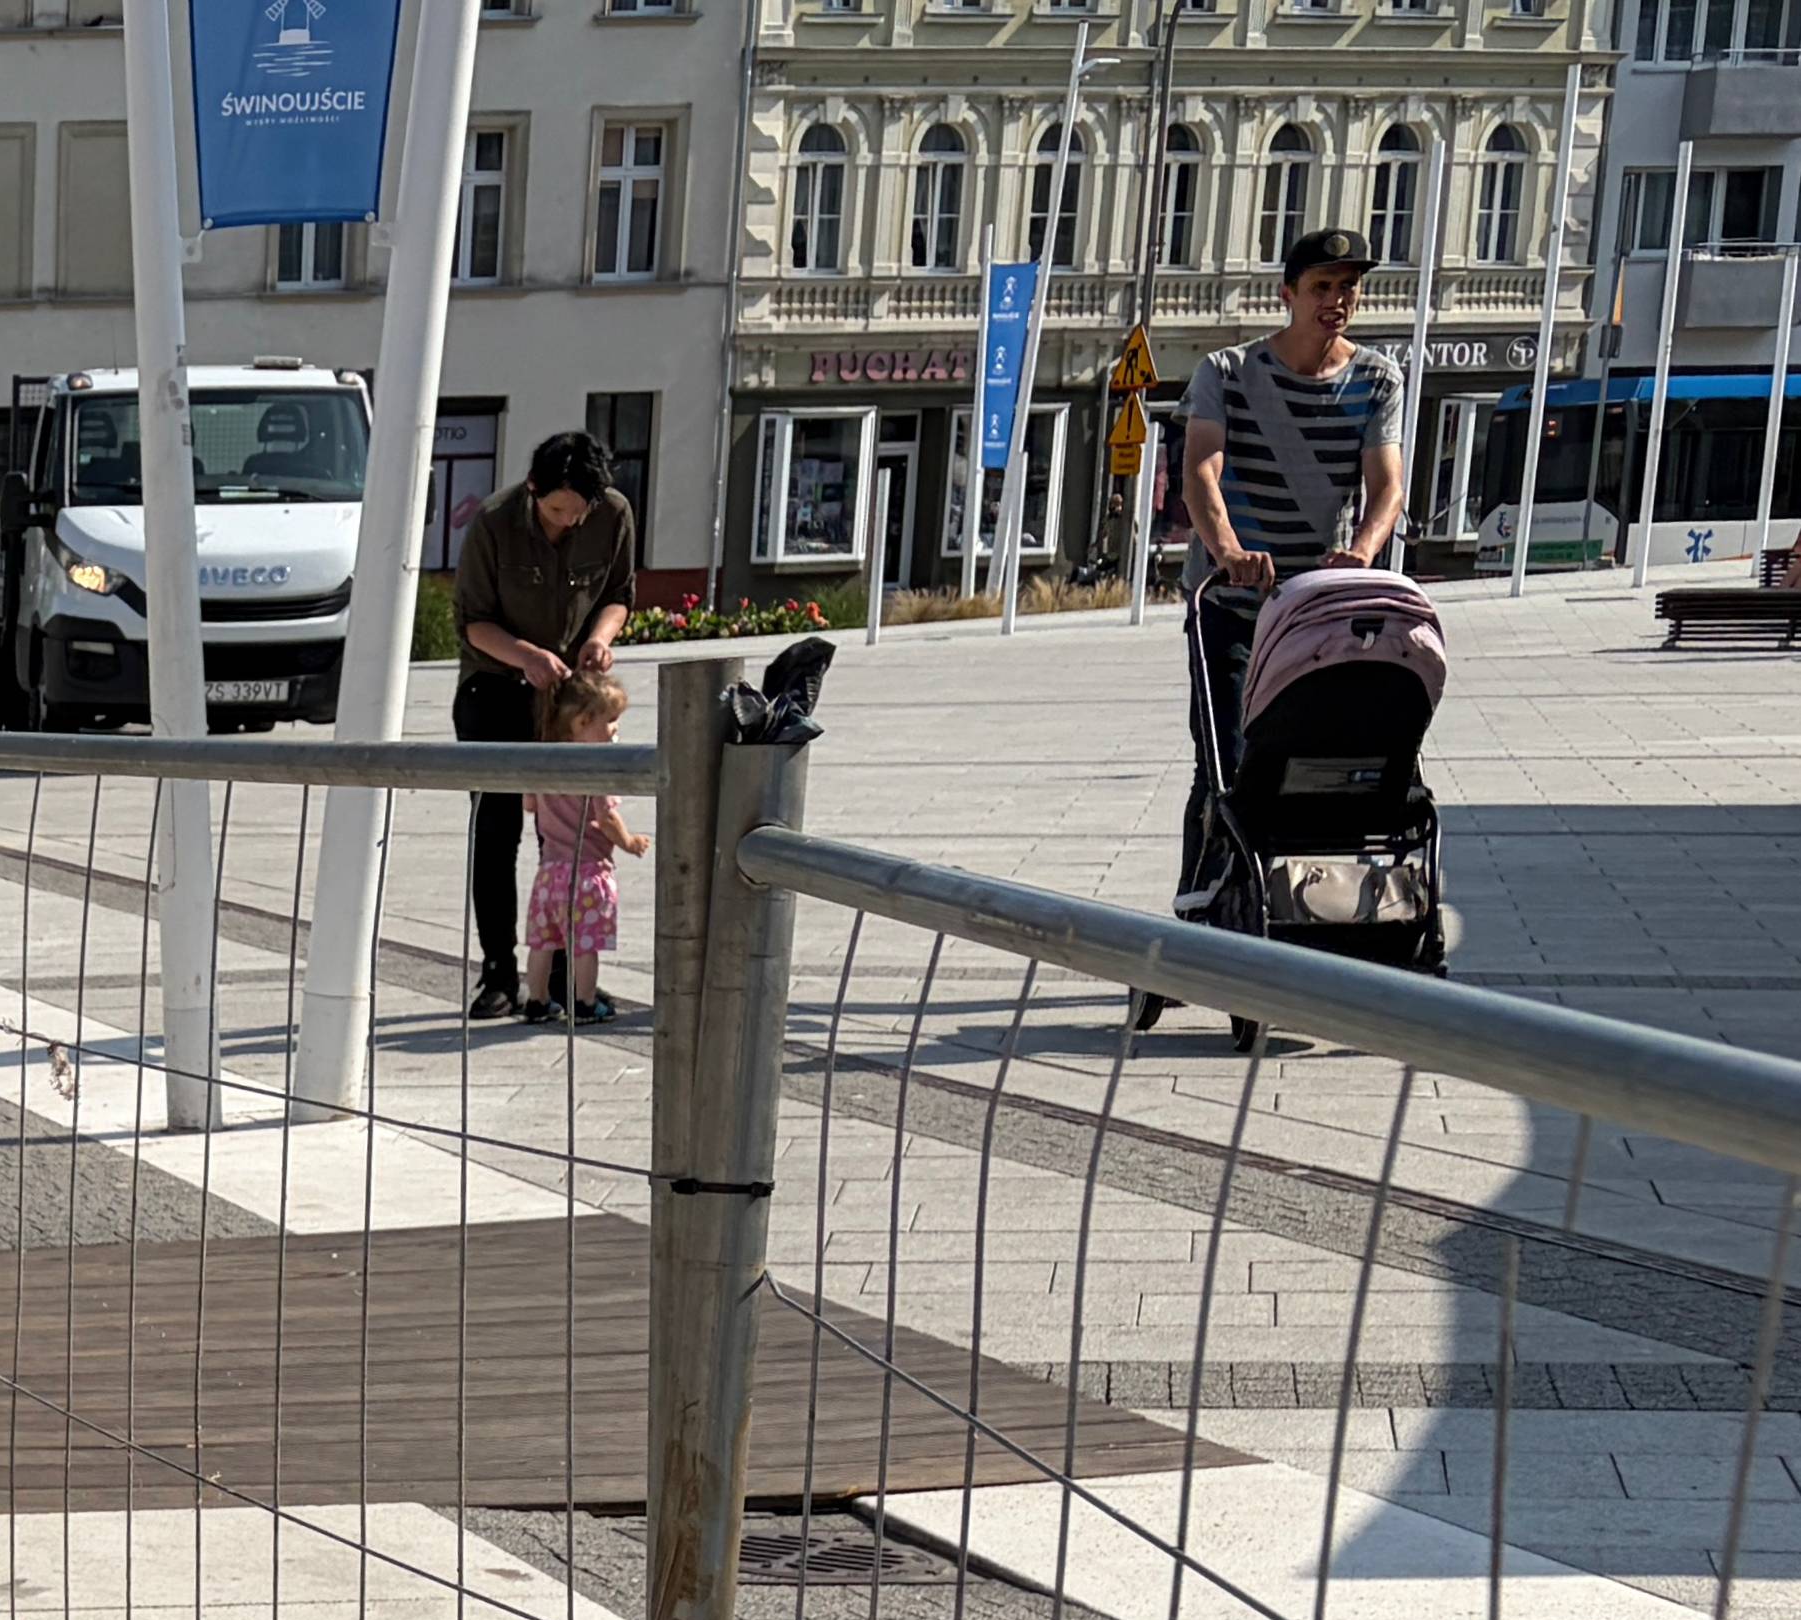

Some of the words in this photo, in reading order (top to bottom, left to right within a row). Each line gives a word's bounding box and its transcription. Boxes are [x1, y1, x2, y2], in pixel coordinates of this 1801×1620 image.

[221, 87, 366, 117] ŚWINOUJŚCIE
[810, 352, 978, 382] PUCHAT
[199, 565, 289, 586] IVECO
[232, 682, 284, 700] 339VT
